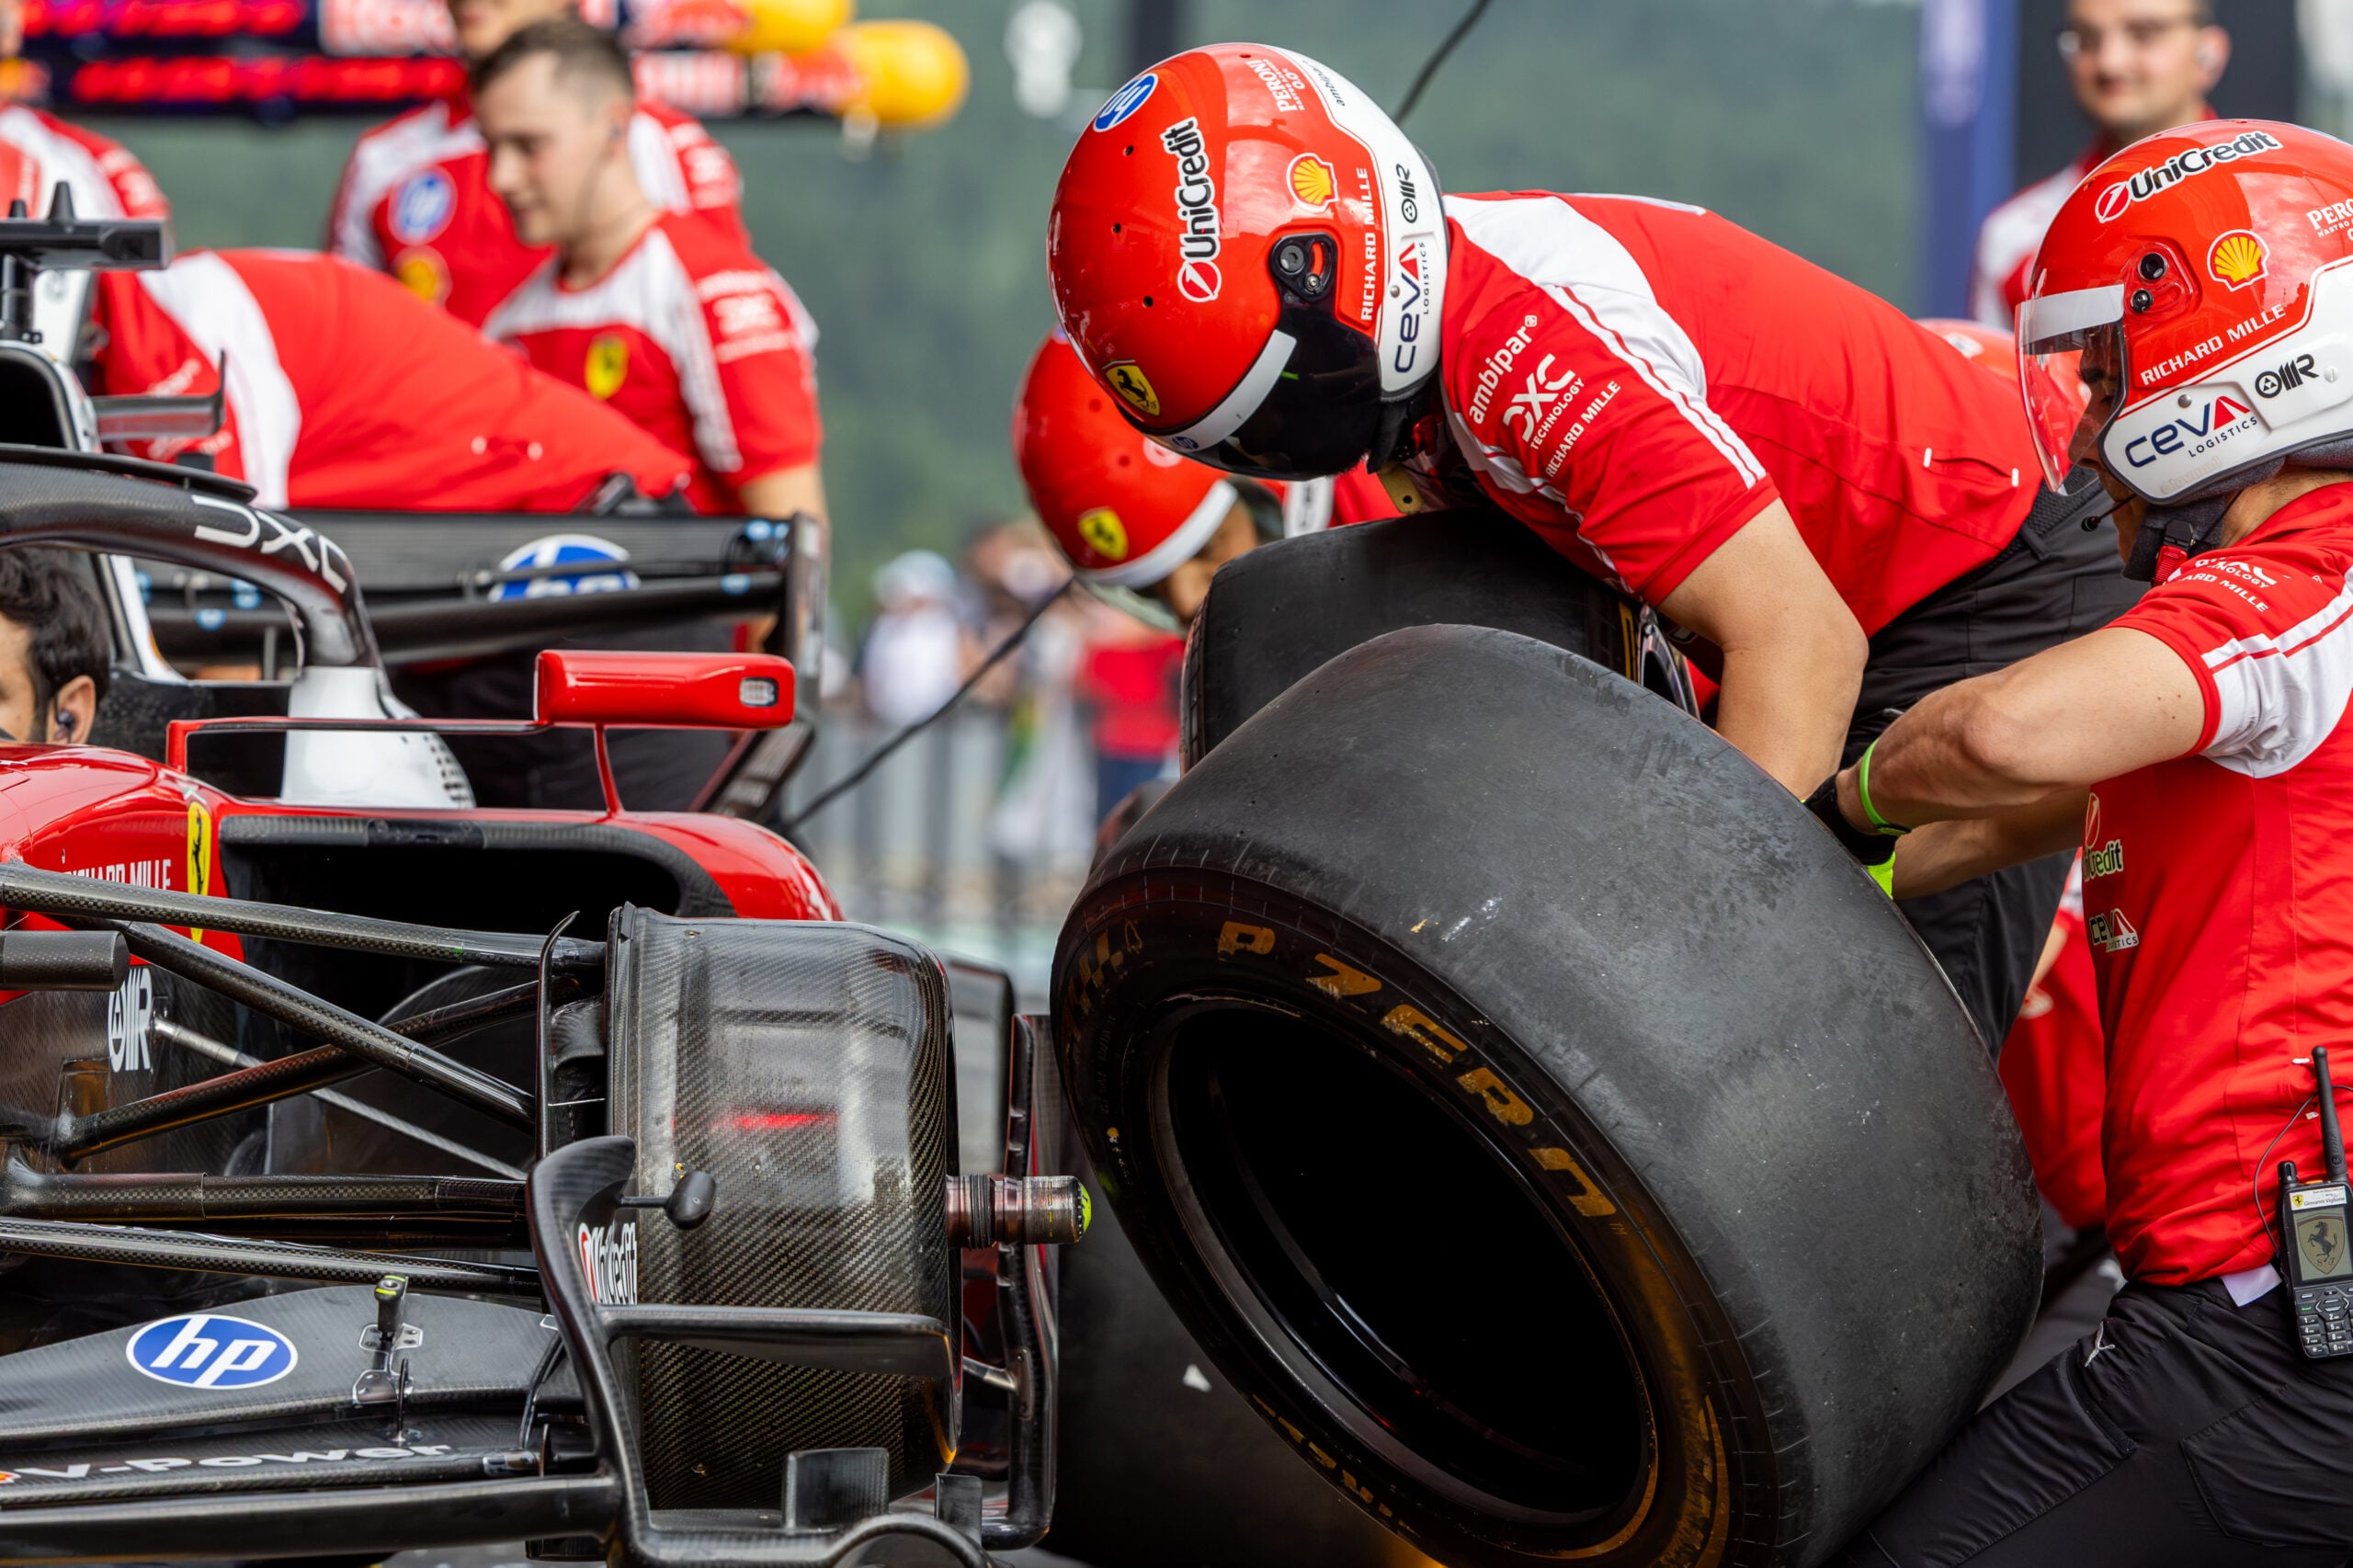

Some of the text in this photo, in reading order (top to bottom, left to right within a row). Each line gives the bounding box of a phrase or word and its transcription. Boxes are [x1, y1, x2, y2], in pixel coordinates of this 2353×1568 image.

[1245, 59, 1298, 112] PERONI
[1164, 119, 1217, 258] UniCredit
[2130, 131, 2280, 199] UniCredit
[1357, 167, 1377, 321] RICHARD MILLE
[1419, 242, 1429, 315] LOGISTICS
[1469, 324, 1532, 425] ambipar
[2140, 303, 2287, 386] RICHARD MILLE
[1502, 353, 1576, 443] DXC
[1530, 377, 1585, 449] TECHNOLOGY
[1545, 381, 1621, 477] RICHARD MILLE
[2188, 416, 2258, 458] LOGISTICS
[191, 494, 347, 594] DXC
[149, 1316, 278, 1388] hp
